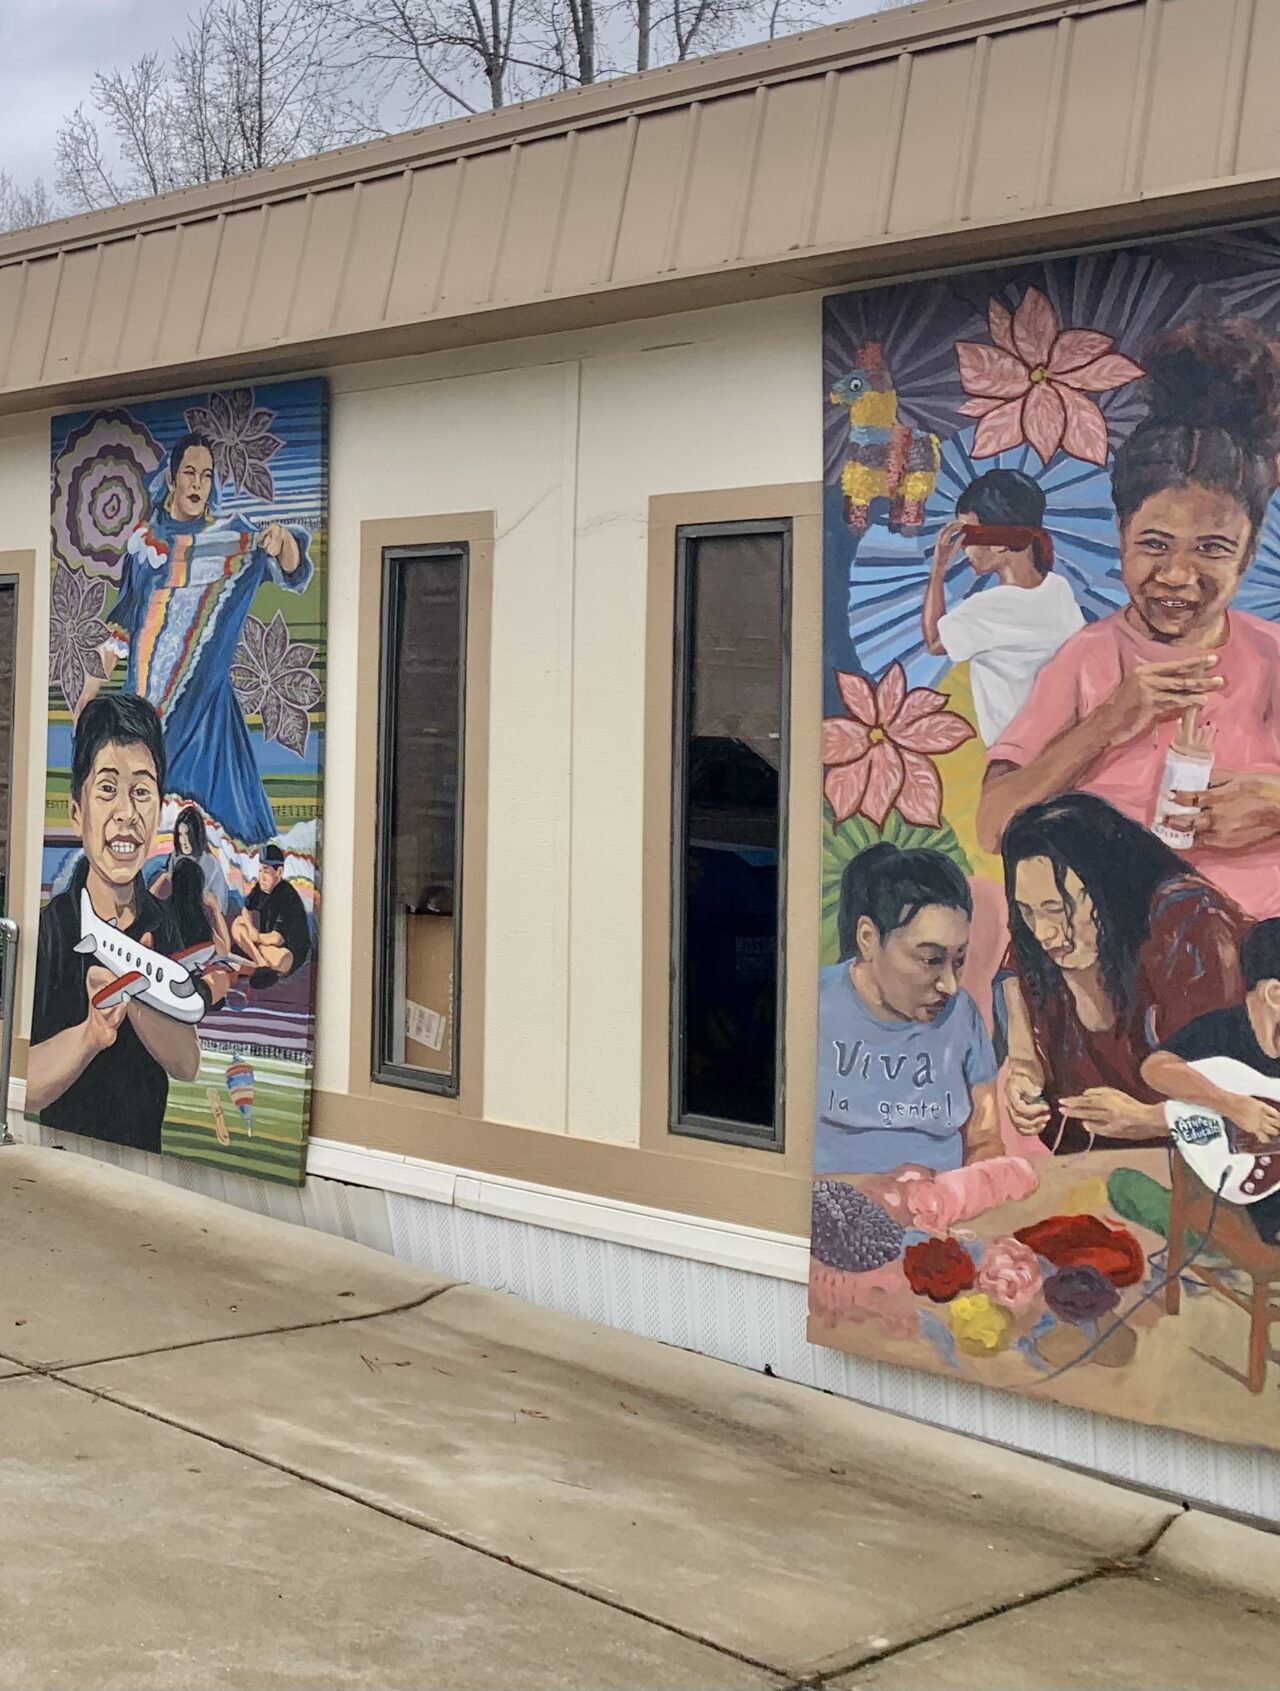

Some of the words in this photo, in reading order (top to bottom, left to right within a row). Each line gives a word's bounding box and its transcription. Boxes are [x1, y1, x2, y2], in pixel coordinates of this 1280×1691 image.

[833, 1039, 936, 1090] Viva
[829, 1088, 850, 1112] la
[878, 1090, 952, 1127] gente!
